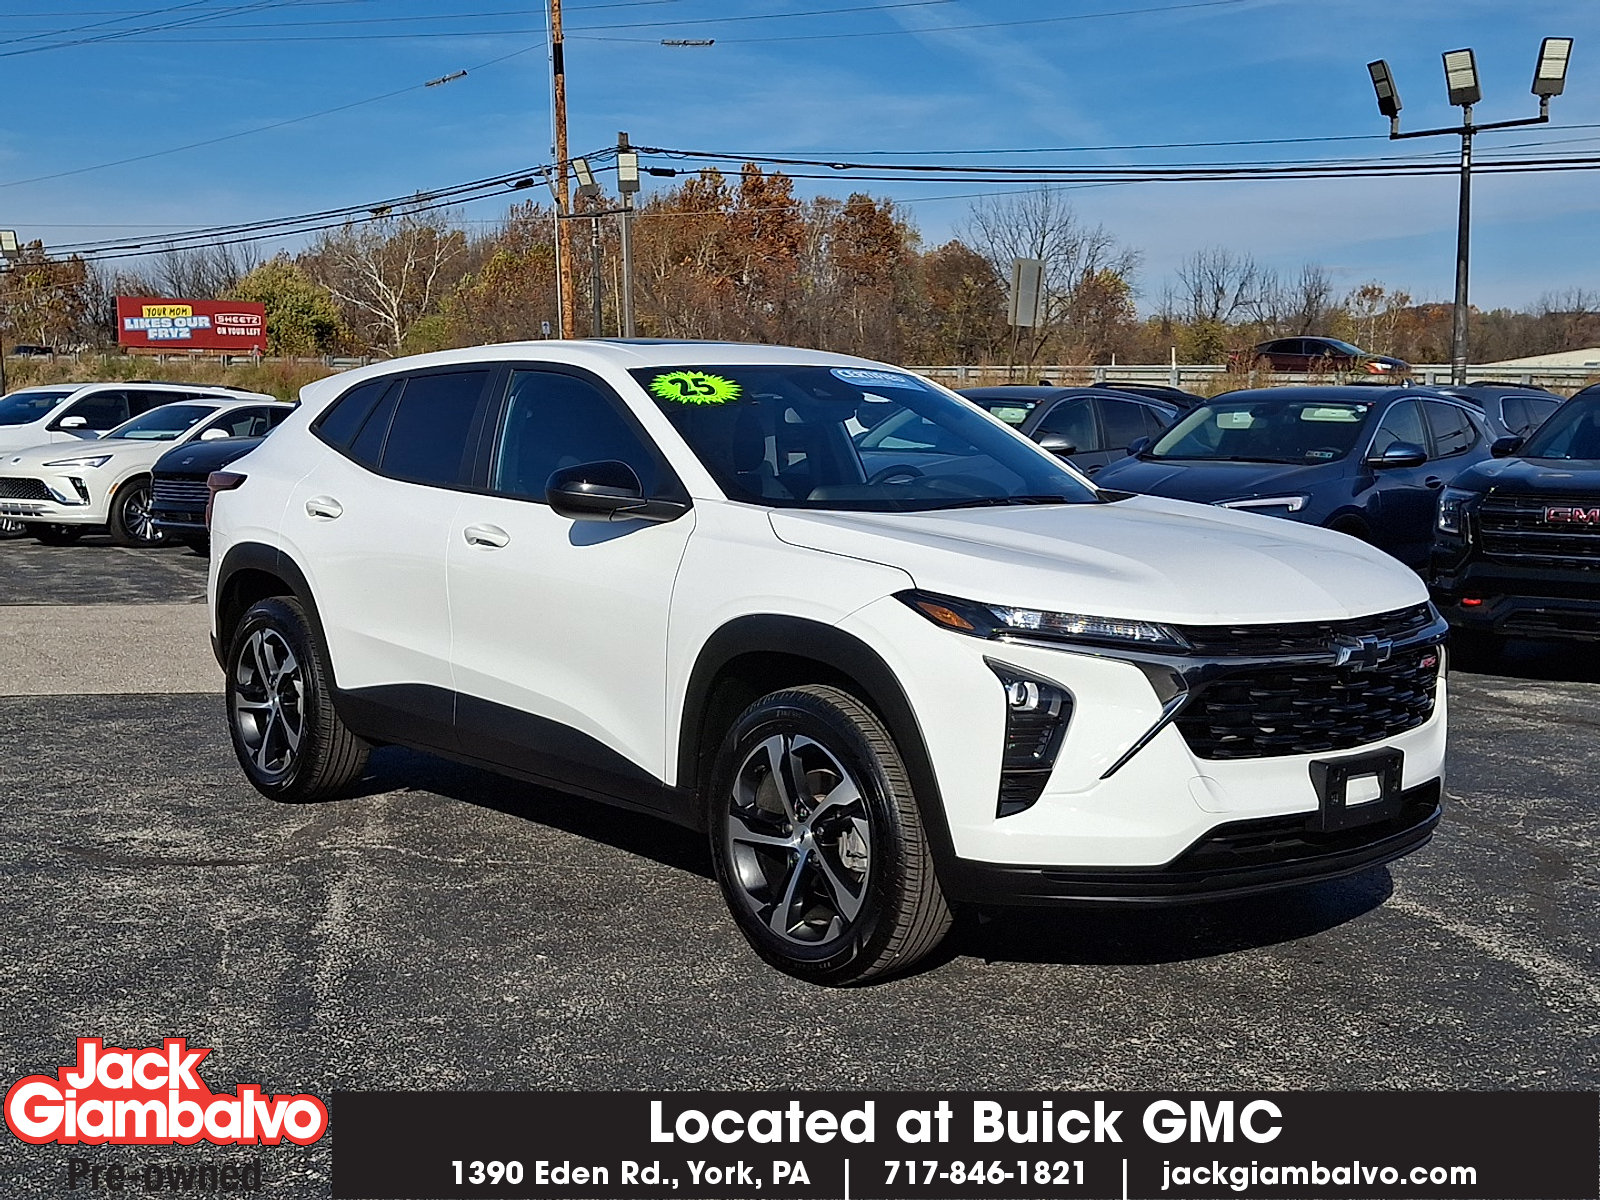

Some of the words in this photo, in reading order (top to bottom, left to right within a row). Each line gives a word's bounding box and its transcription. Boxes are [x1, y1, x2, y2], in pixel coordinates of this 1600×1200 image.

[146, 307, 167, 316] YOUR
[169, 307, 188, 316] MOM
[124, 318, 172, 329] LIKES
[173, 317, 211, 328] OUR
[217, 315, 258, 324] SHEETZ
[148, 328, 191, 339] FRYZ
[216, 326, 227, 335] ON
[228, 327, 246, 336] YOUR
[246, 327, 261, 336] LEFT
[667, 377, 716, 396] 25
